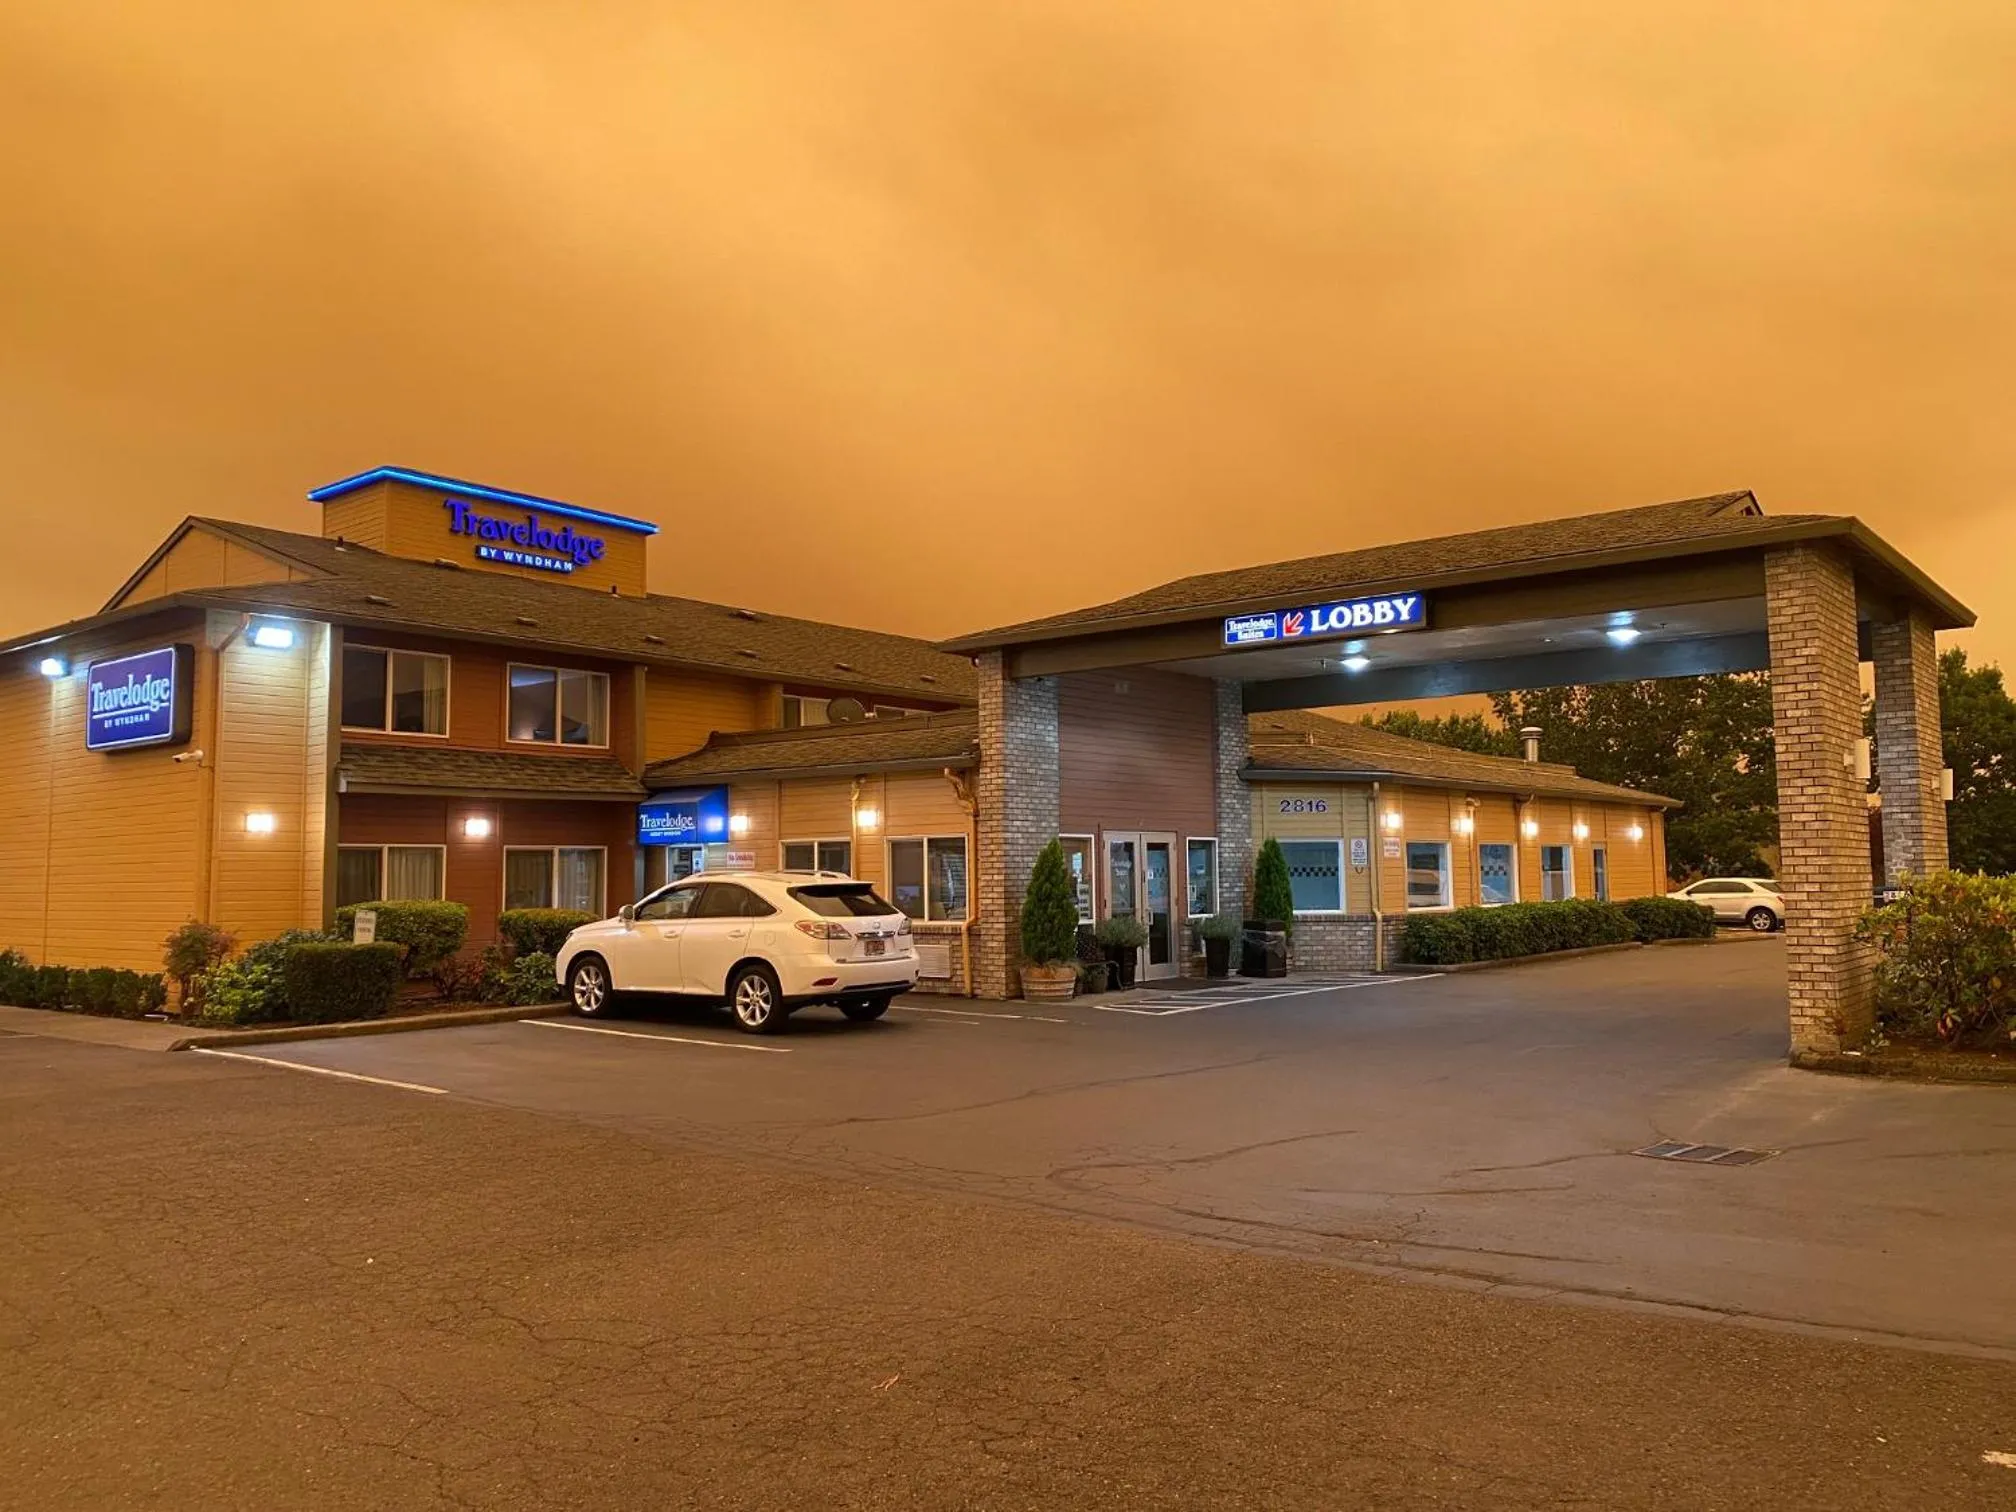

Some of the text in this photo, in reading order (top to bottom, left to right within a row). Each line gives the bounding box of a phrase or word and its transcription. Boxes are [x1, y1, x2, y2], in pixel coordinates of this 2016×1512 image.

[444, 498, 605, 565] Travelodge
[480, 547, 573, 572] BY WYNDHAM
[1228, 618, 1275, 633] Travelodge
[1310, 597, 1416, 632] LOBBY
[91, 673, 170, 712] Travelodge
[1280, 799, 1327, 813] 2816
[640, 812, 694, 832] Travelodge
